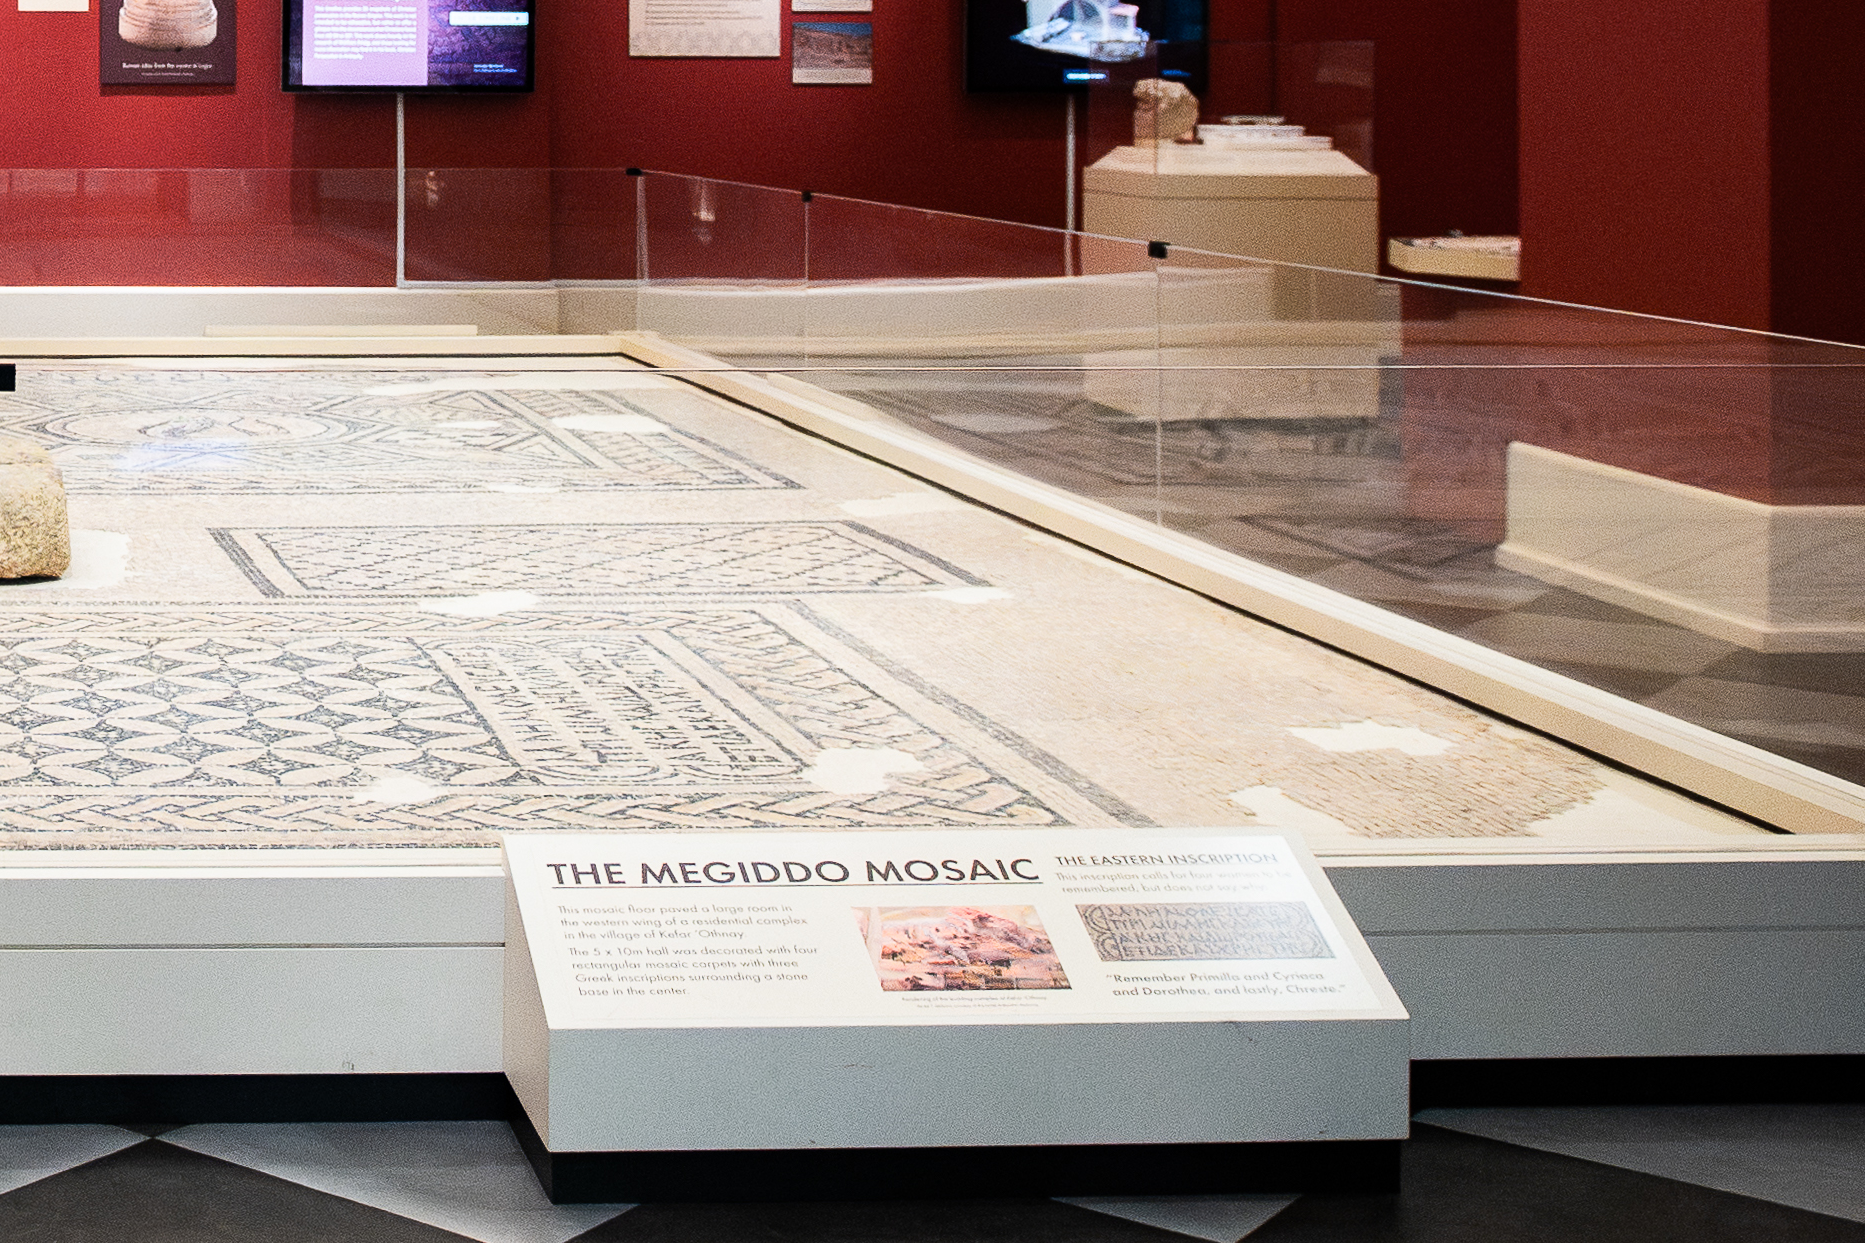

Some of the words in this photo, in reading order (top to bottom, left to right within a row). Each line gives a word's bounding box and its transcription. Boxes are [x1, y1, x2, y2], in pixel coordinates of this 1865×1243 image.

[1055, 856, 1087, 865] THE
[1090, 855, 1164, 865] EASTERN
[1168, 853, 1279, 864] INSCRIPTION
[547, 863, 626, 885] THE
[641, 860, 849, 884] MEGIDDO
[865, 859, 1039, 882] MOSAIC
[558, 905, 579, 914] This
[583, 905, 625, 914] mosaic
[628, 904, 655, 913] floor
[659, 905, 698, 915] paved
[712, 904, 744, 915] large
[561, 918, 579, 926] the
[582, 918, 629, 926] western
[632, 918, 662, 928] wing
[665, 916, 677, 926] of
[692, 916, 753, 926] residential
[756, 915, 808, 926] complex
[564, 931, 575, 939] in
[578, 931, 596, 939] the
[600, 930, 640, 941] village
[643, 929, 656, 938] of
[659, 929, 692, 938] Kefar
[568, 947, 589, 956] The
[617, 947, 643, 956] 10m
[646, 946, 669, 956] hall
[700, 945, 763, 955] decorated
[766, 945, 791, 954] with
[794, 944, 818, 954] four
[572, 960, 641, 972] rectangular
[646, 960, 689, 969] mosaic
[692, 960, 737, 970] carpets
[740, 958, 765, 968] with
[767, 958, 799, 968] three
[575, 973, 614, 983] Greek
[617, 973, 685, 984] inscriptions
[688, 972, 761, 983] surrounding
[776, 973, 808, 981] stone
[1189, 972, 1241, 982] Primilla
[1244, 971, 1269, 981] and
[578, 987, 609, 996] base
[612, 987, 624, 995] in
[627, 986, 646, 996] the
[1112, 987, 1139, 996] and
[1214, 985, 1241, 995] and
